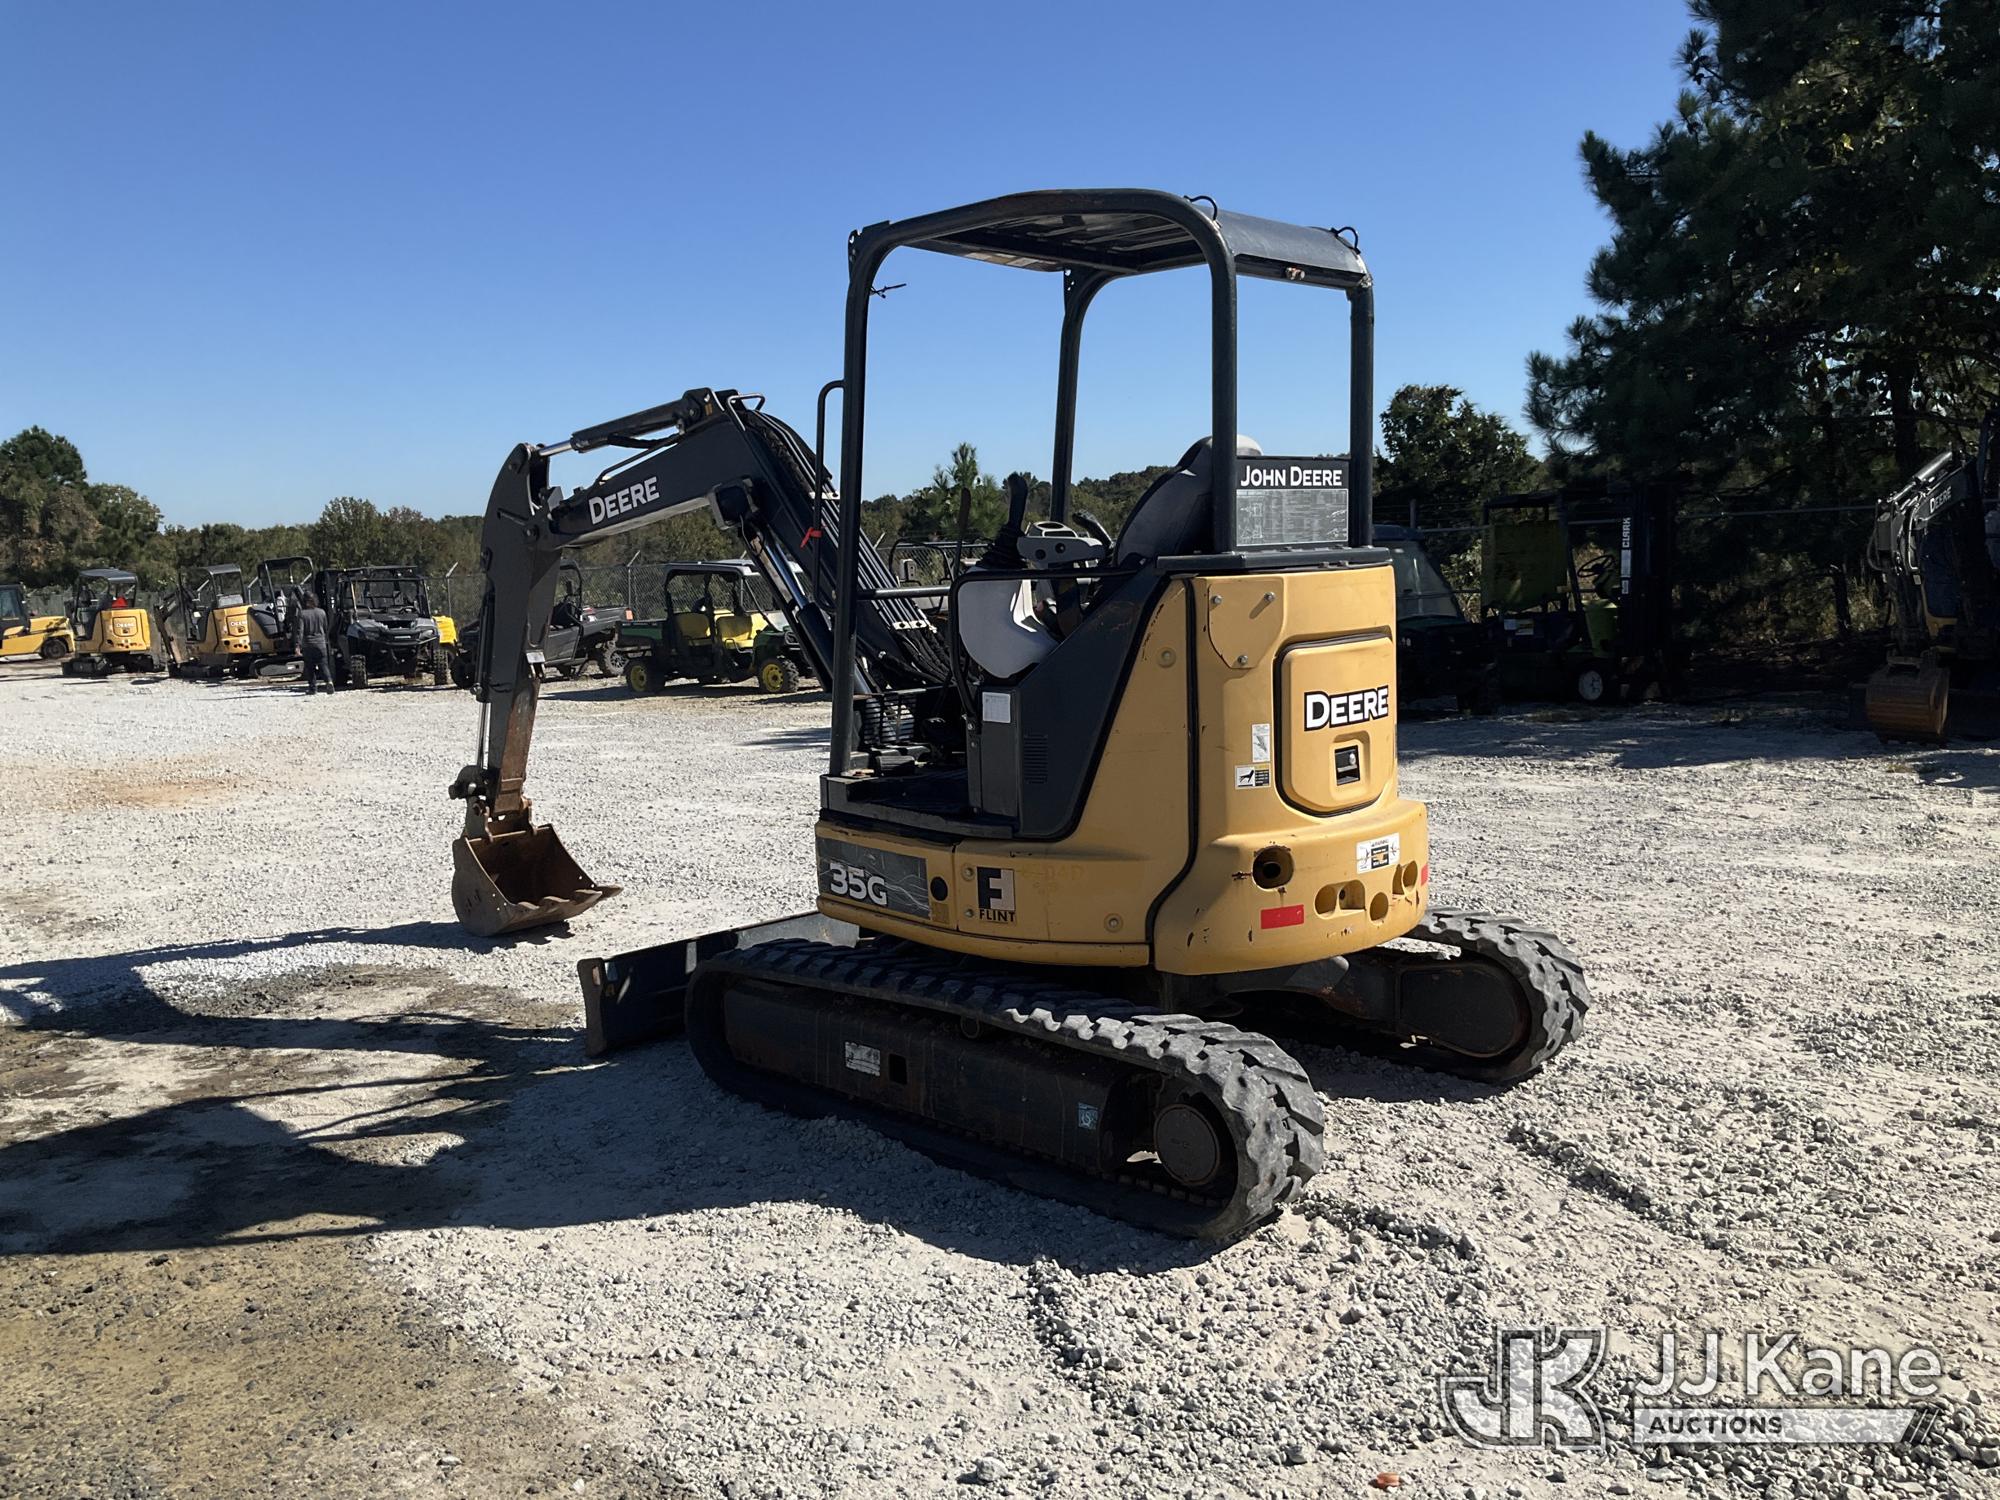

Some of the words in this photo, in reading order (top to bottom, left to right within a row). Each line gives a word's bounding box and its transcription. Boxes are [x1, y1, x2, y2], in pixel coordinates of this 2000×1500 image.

[1240, 465, 1286, 487] JOHN
[1290, 466, 1343, 487] DEERE
[588, 476, 660, 525] DEERE
[1621, 516, 1632, 548] CLARK
[1304, 686, 1389, 731] DEERE
[829, 862, 888, 906] 35G
[979, 909, 1015, 922] FLINT
